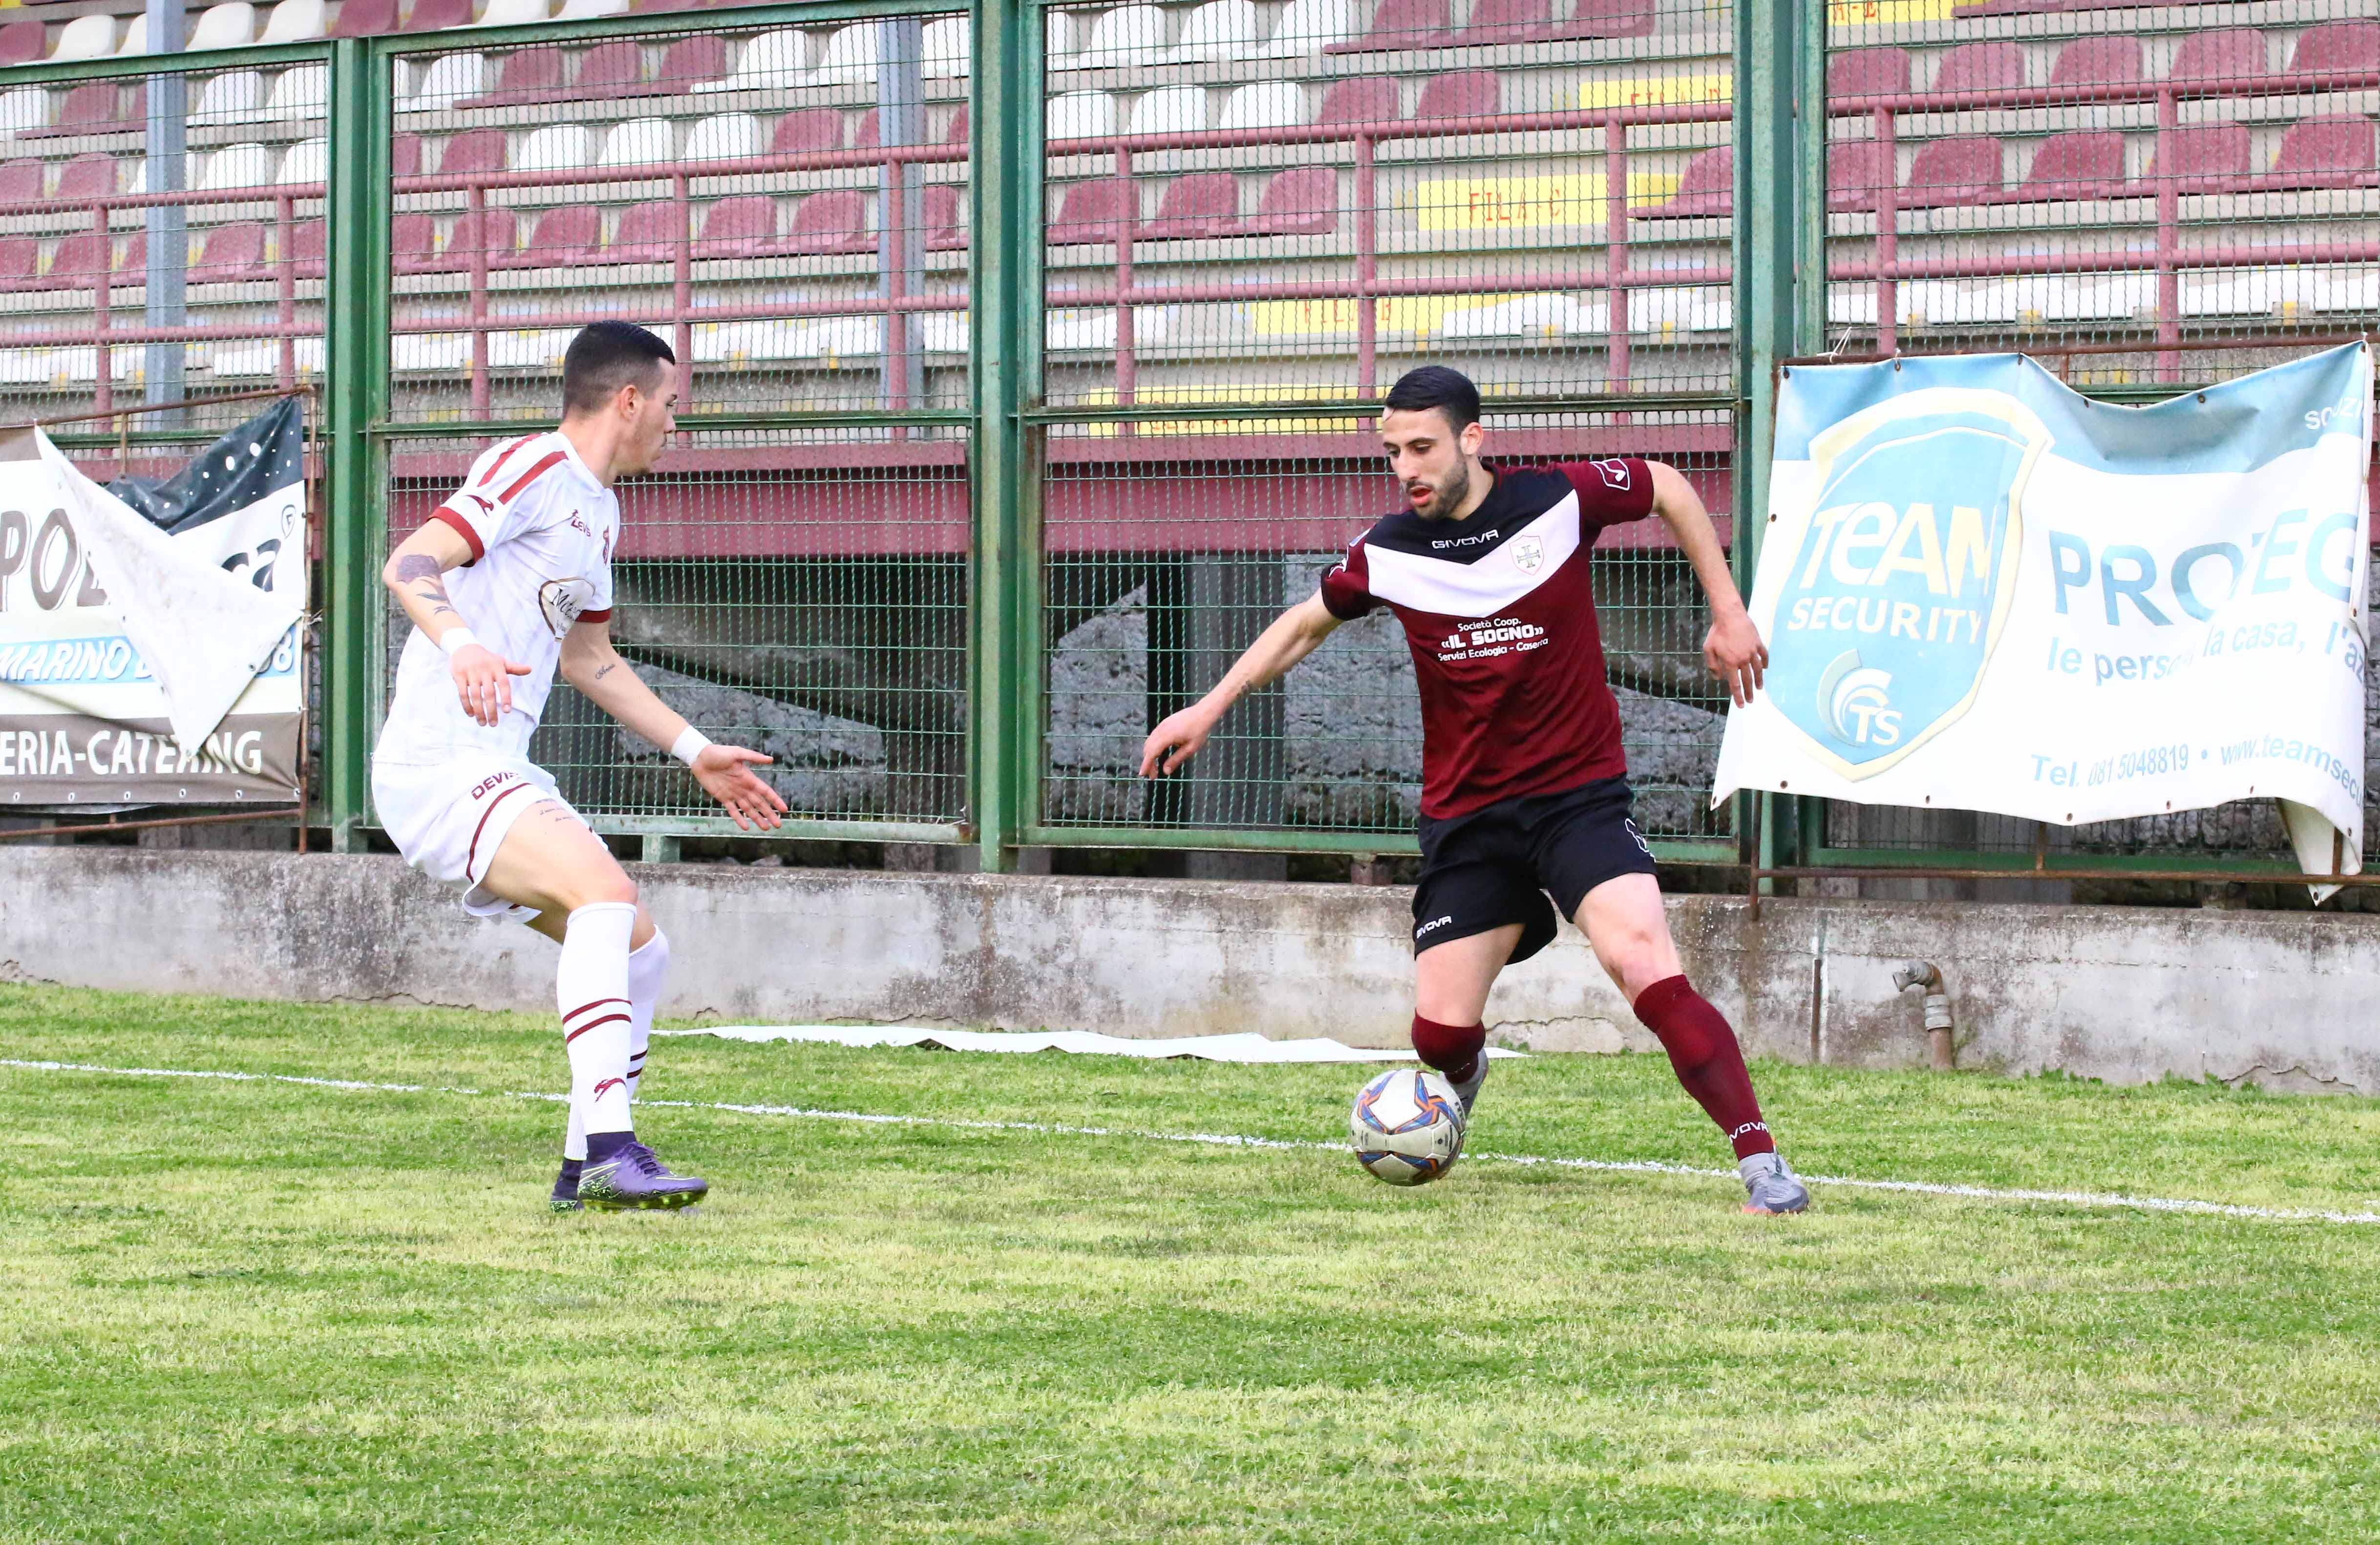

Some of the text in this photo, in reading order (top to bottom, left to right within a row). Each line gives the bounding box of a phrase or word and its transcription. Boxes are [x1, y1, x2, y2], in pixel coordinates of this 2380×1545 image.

[1431, 529, 1499, 549] GIVOVA
[2048, 508, 2358, 627] PROEG
[1457, 617, 1522, 632] Società Coop.
[1786, 596, 1982, 645] SECURITY
[2047, 636, 2082, 674] le
[1849, 703, 1903, 746] TS
